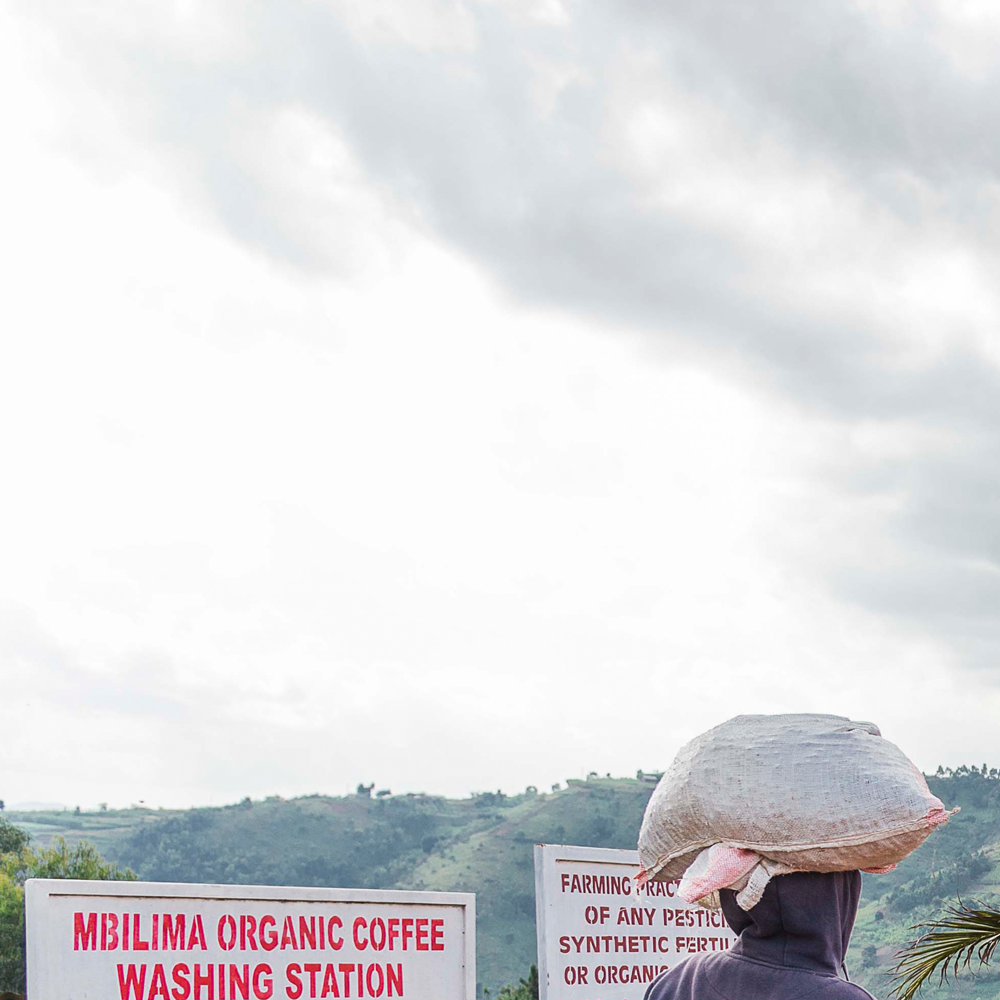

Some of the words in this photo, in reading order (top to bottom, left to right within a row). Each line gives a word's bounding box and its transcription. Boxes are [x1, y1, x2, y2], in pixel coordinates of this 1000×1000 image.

[561, 873, 631, 895] FARMING
[585, 905, 610, 924] OF
[617, 907, 656, 926] ANY
[73, 912, 208, 951] MBILIMA
[217, 914, 344, 951] ORGANIC
[352, 916, 445, 951] COFFEE
[559, 935, 669, 954] SYNTHETIC
[285, 962, 404, 1000] STATION
[564, 966, 589, 985] OR
